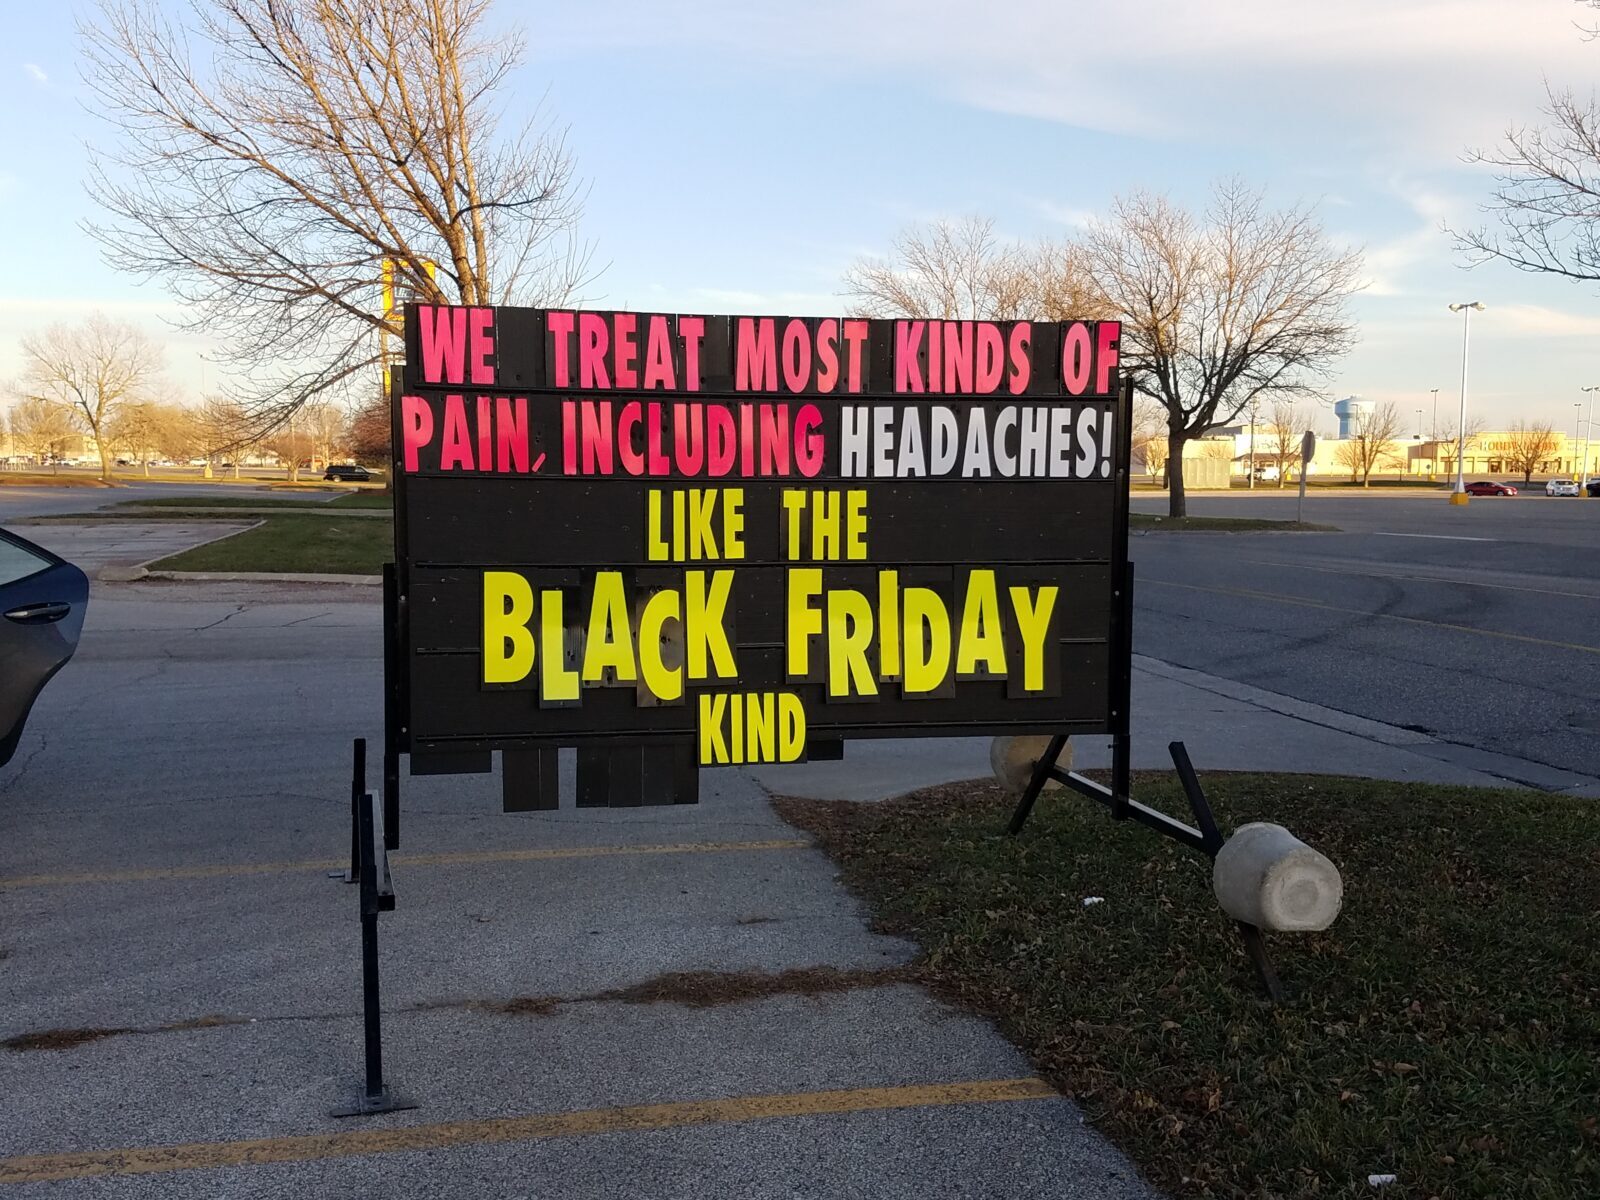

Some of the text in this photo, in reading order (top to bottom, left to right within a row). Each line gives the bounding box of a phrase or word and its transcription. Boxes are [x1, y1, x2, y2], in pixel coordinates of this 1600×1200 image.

[418, 305, 1120, 396] WE TREAT MOST KINDS OF
[401, 394, 1113, 479] PAIN, INCLUDING HEADACHES!
[648, 488, 867, 562] LIKE THE
[483, 568, 1059, 702] BLACK FRIDAY
[699, 692, 806, 765] KIND
